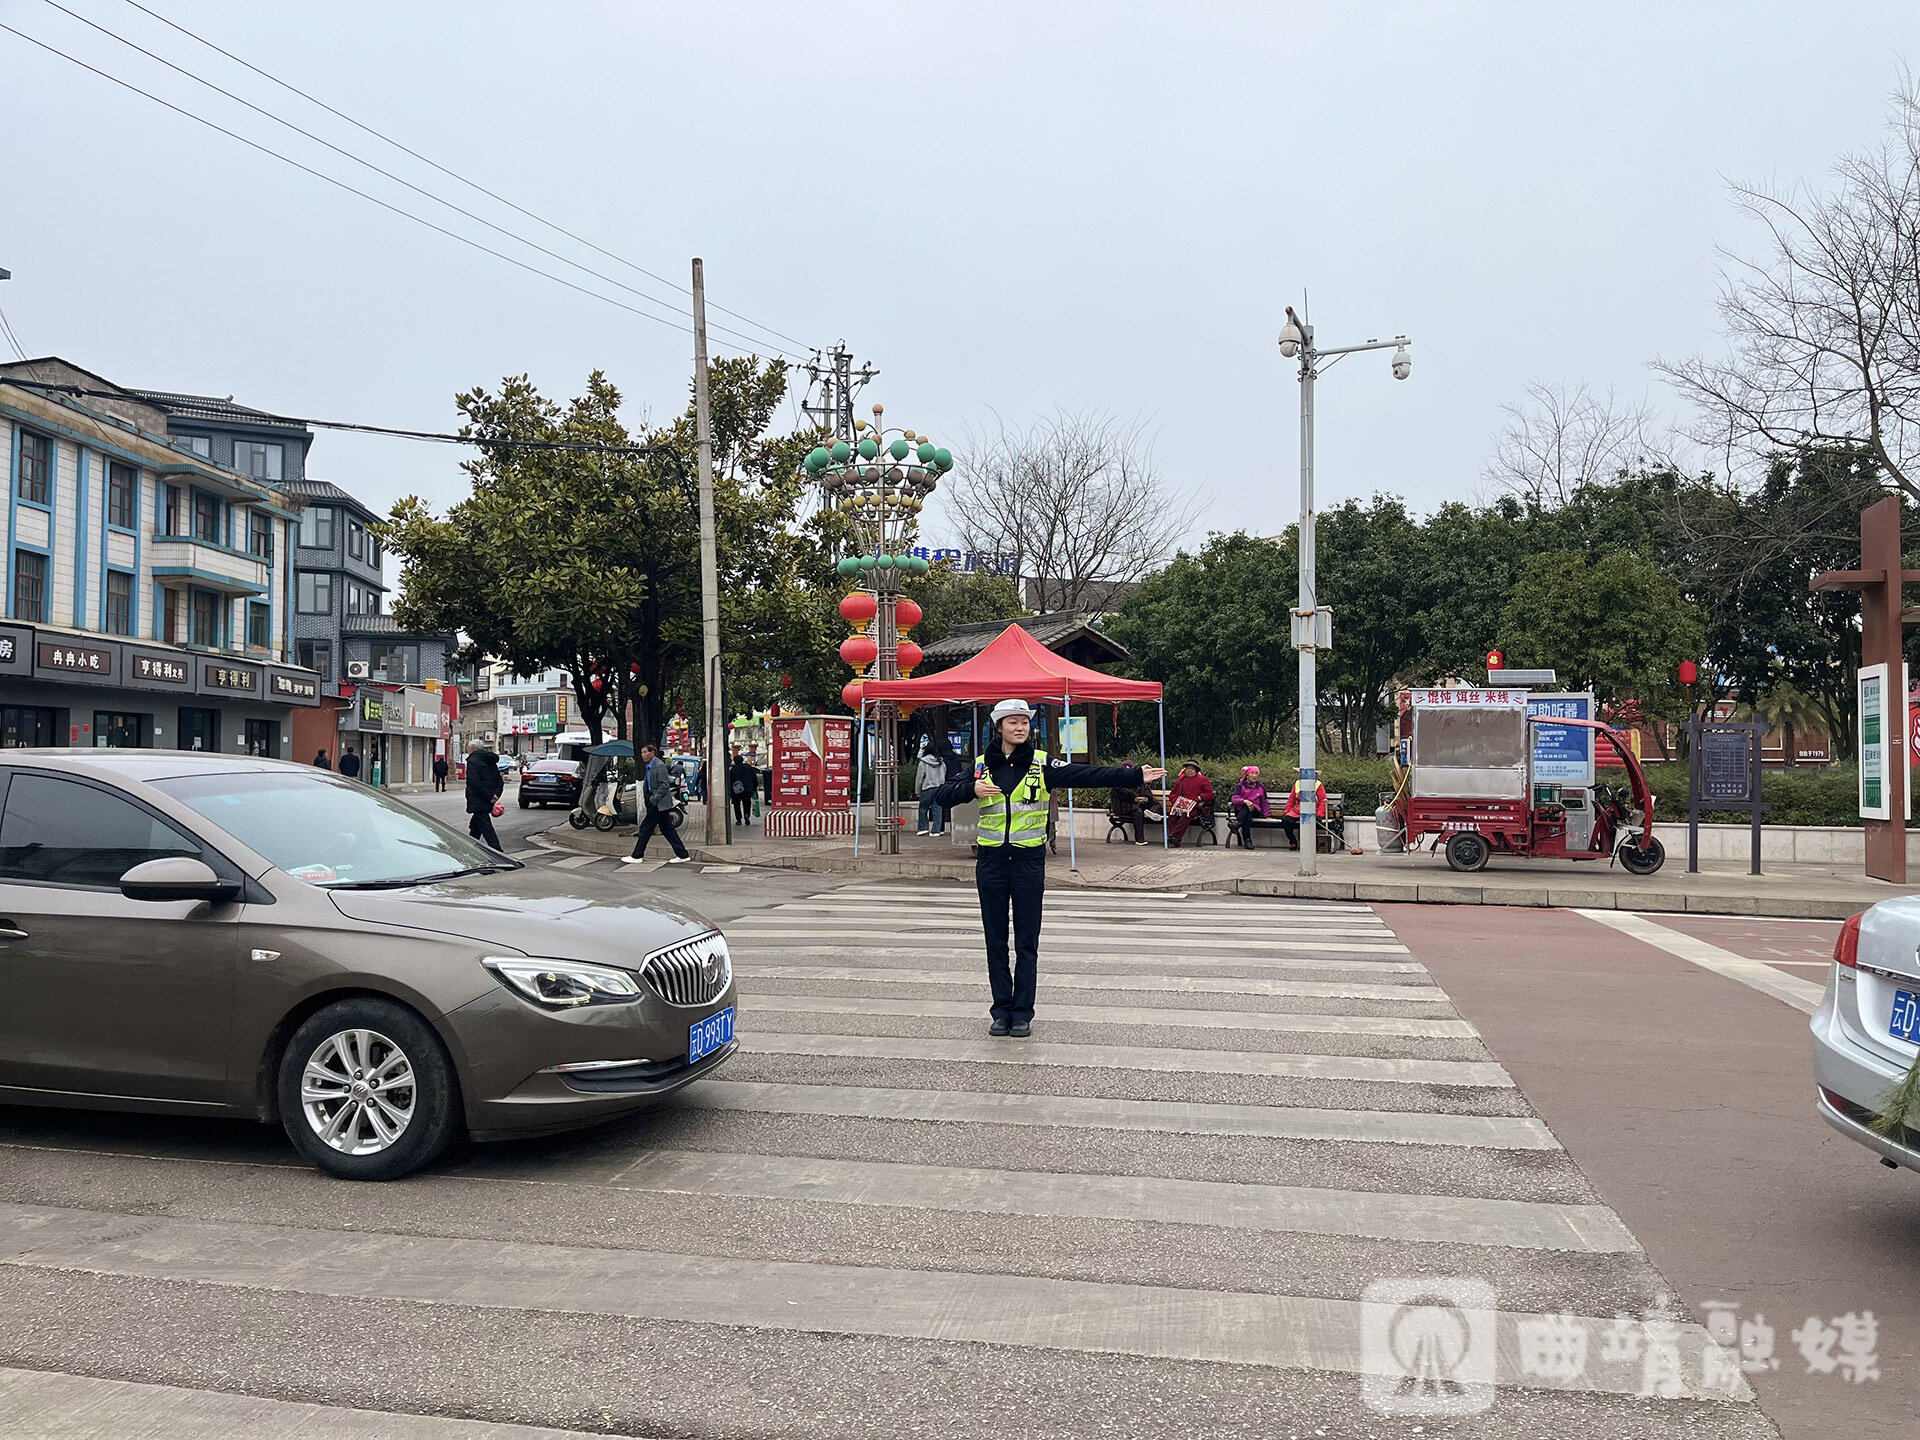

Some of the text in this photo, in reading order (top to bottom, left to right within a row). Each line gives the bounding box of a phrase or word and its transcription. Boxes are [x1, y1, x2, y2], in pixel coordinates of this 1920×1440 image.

[52, 649, 100, 669] 冉冉小吃
[217, 669, 250, 688] 亨得利
[1427, 690, 1510, 704] 馄饨 饵丝 米线
[1892, 997, 1920, 1033] 云D·
